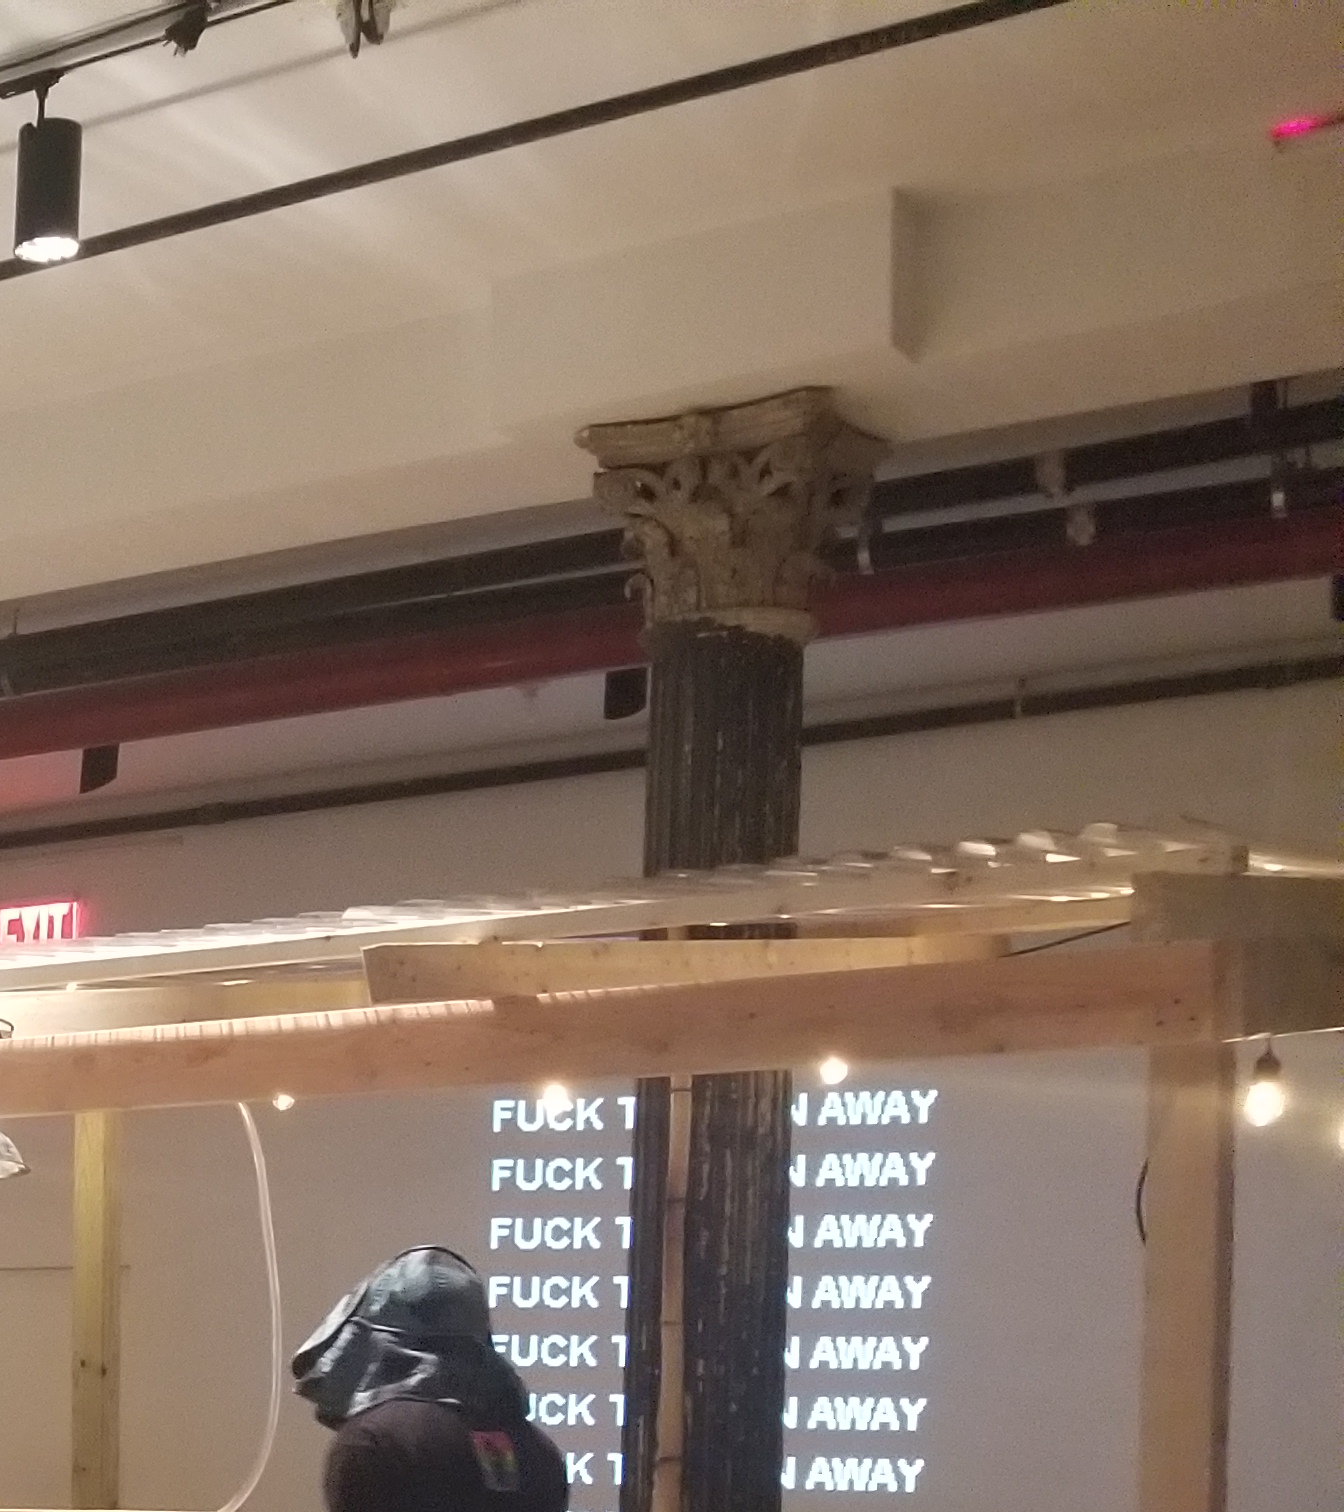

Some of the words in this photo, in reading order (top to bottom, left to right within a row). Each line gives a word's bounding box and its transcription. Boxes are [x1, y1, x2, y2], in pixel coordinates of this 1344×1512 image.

[492, 1097, 605, 1133] FUCK
[817, 1089, 939, 1127] AWAY
[491, 1157, 604, 1192] FUCK
[814, 1151, 936, 1188] AWAY
[489, 1216, 602, 1250] FUCK
[813, 1212, 934, 1249] AWAY
[488, 1275, 600, 1309] FUCK
[811, 1274, 932, 1309] AWAY
[808, 1335, 930, 1371] AWAY
[806, 1396, 928, 1432] AWAY
[804, 1456, 925, 1493] AWAY
